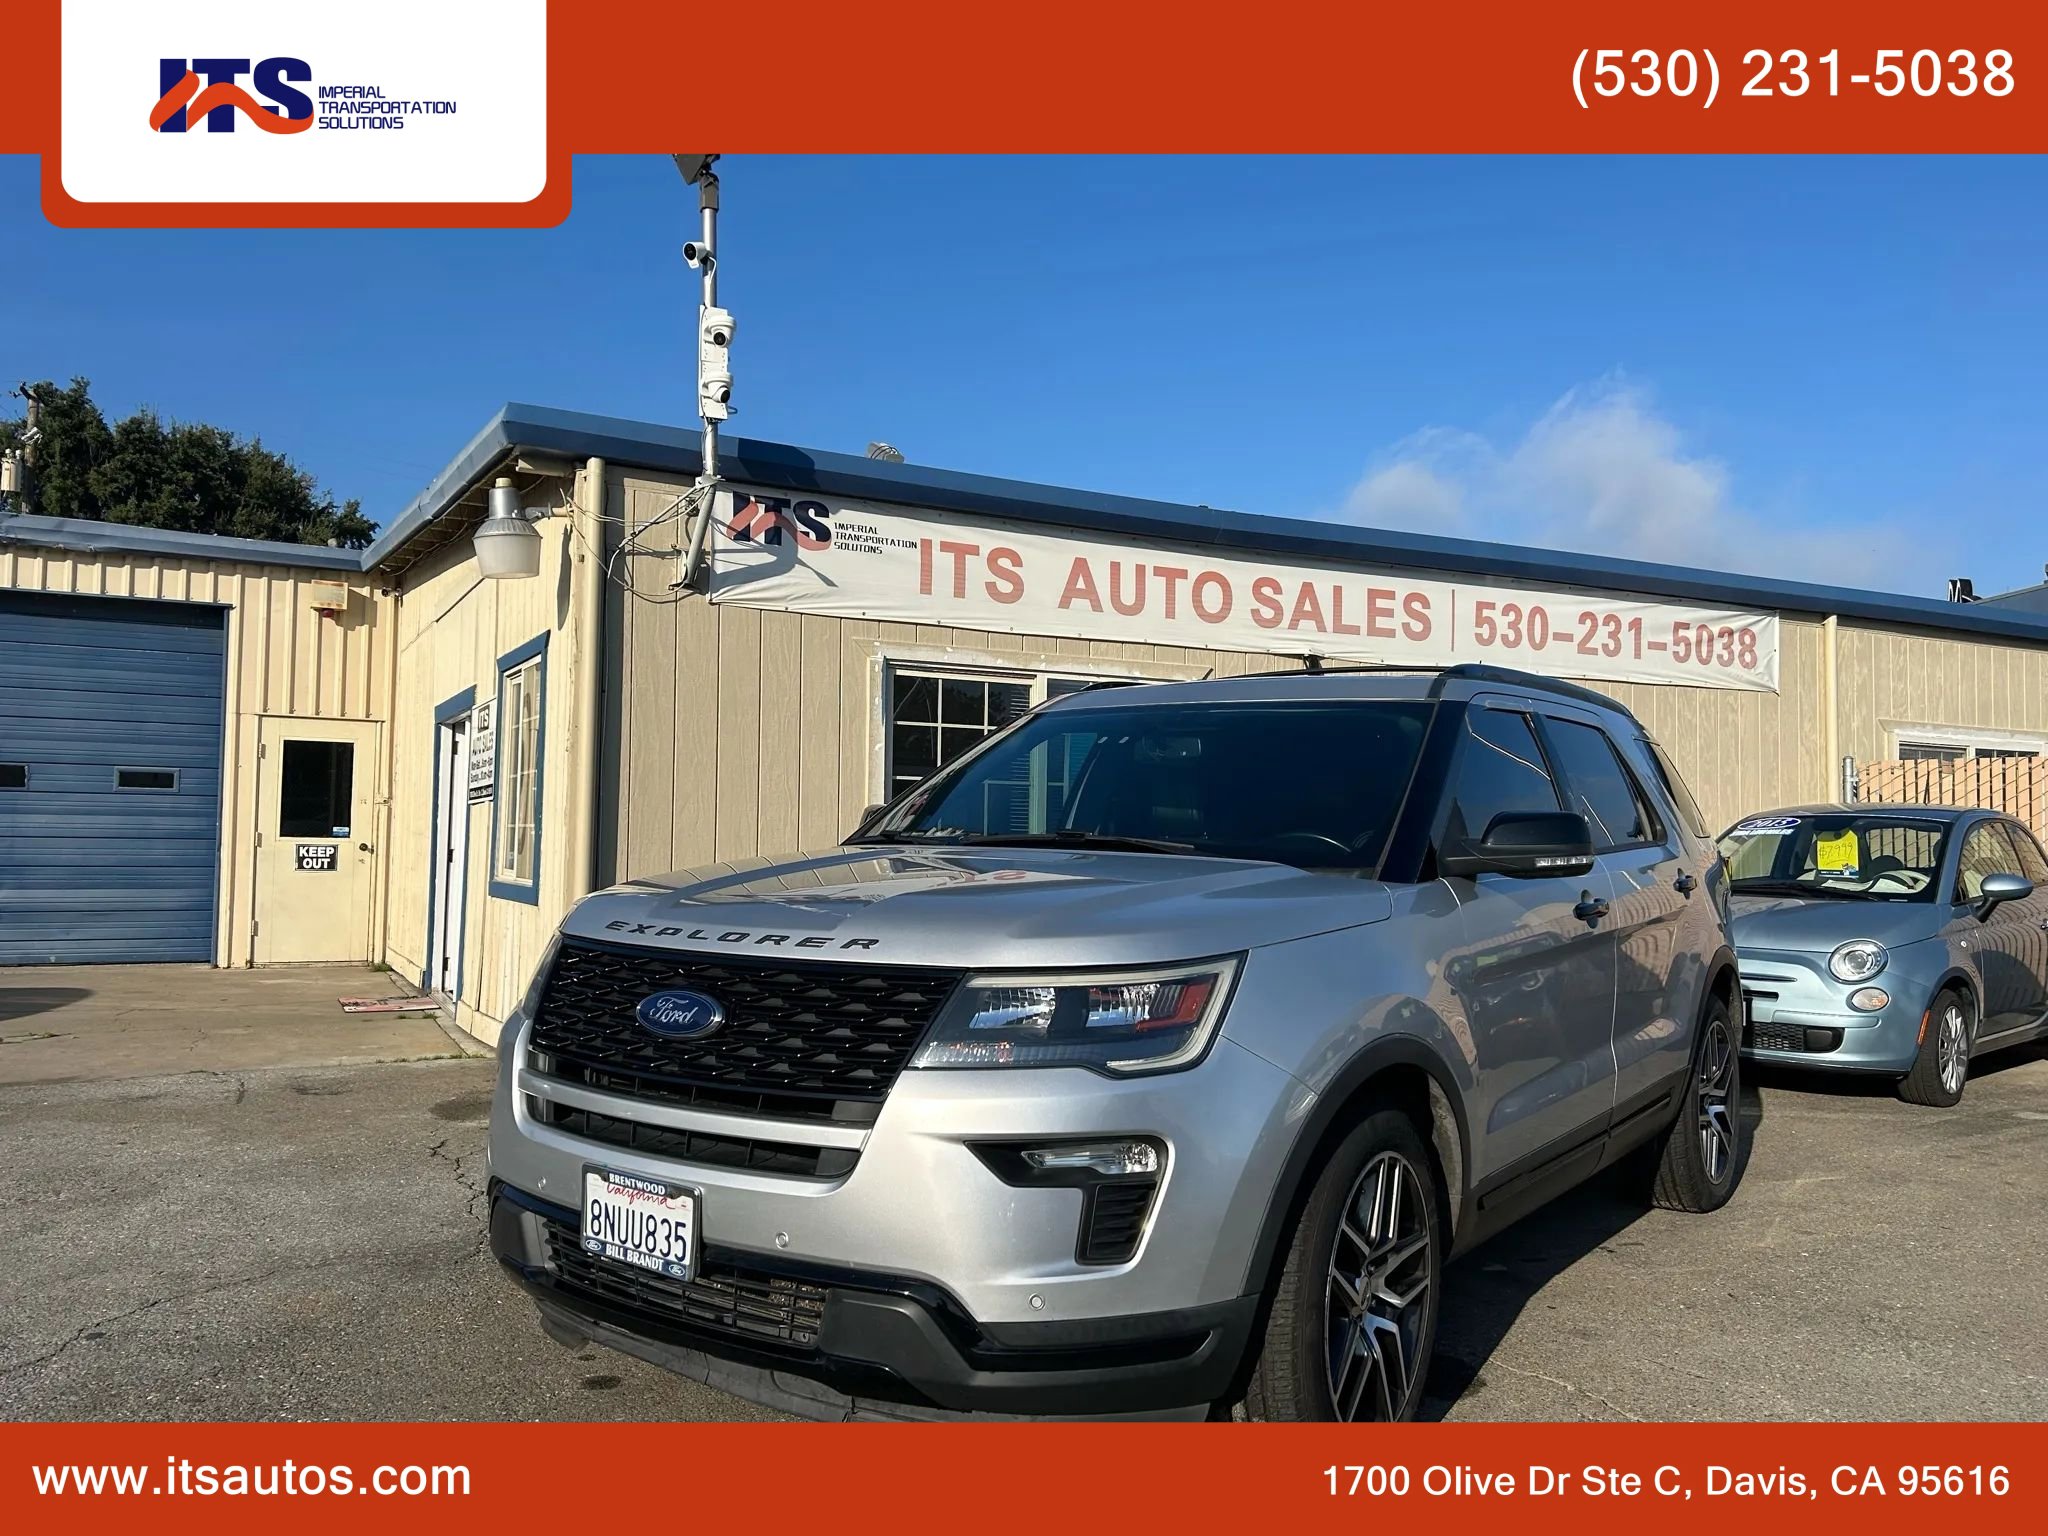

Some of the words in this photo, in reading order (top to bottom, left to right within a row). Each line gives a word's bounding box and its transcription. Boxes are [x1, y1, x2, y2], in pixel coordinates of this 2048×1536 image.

[726, 491, 832, 551] ITS
[834, 522, 878, 535] IMPERIAL
[833, 541, 883, 555] SOLUTONS
[835, 531, 918, 550] TRANSPORTATION
[919, 538, 1025, 605] ITS
[1057, 556, 1234, 624] AUTO
[1250, 576, 1433, 642] SALES
[1474, 600, 1758, 670] 530-231-5038
[299, 846, 335, 858] KEEP
[302, 857, 331, 869] OUT
[605, 920, 880, 950] EXPLORER
[649, 996, 698, 1025] Ford
[608, 1173, 666, 1196] BRENTWOOD
[590, 1198, 687, 1263] 8NUU835
[605, 1243, 625, 1260] BILL
[626, 1249, 664, 1272] BRANDT
